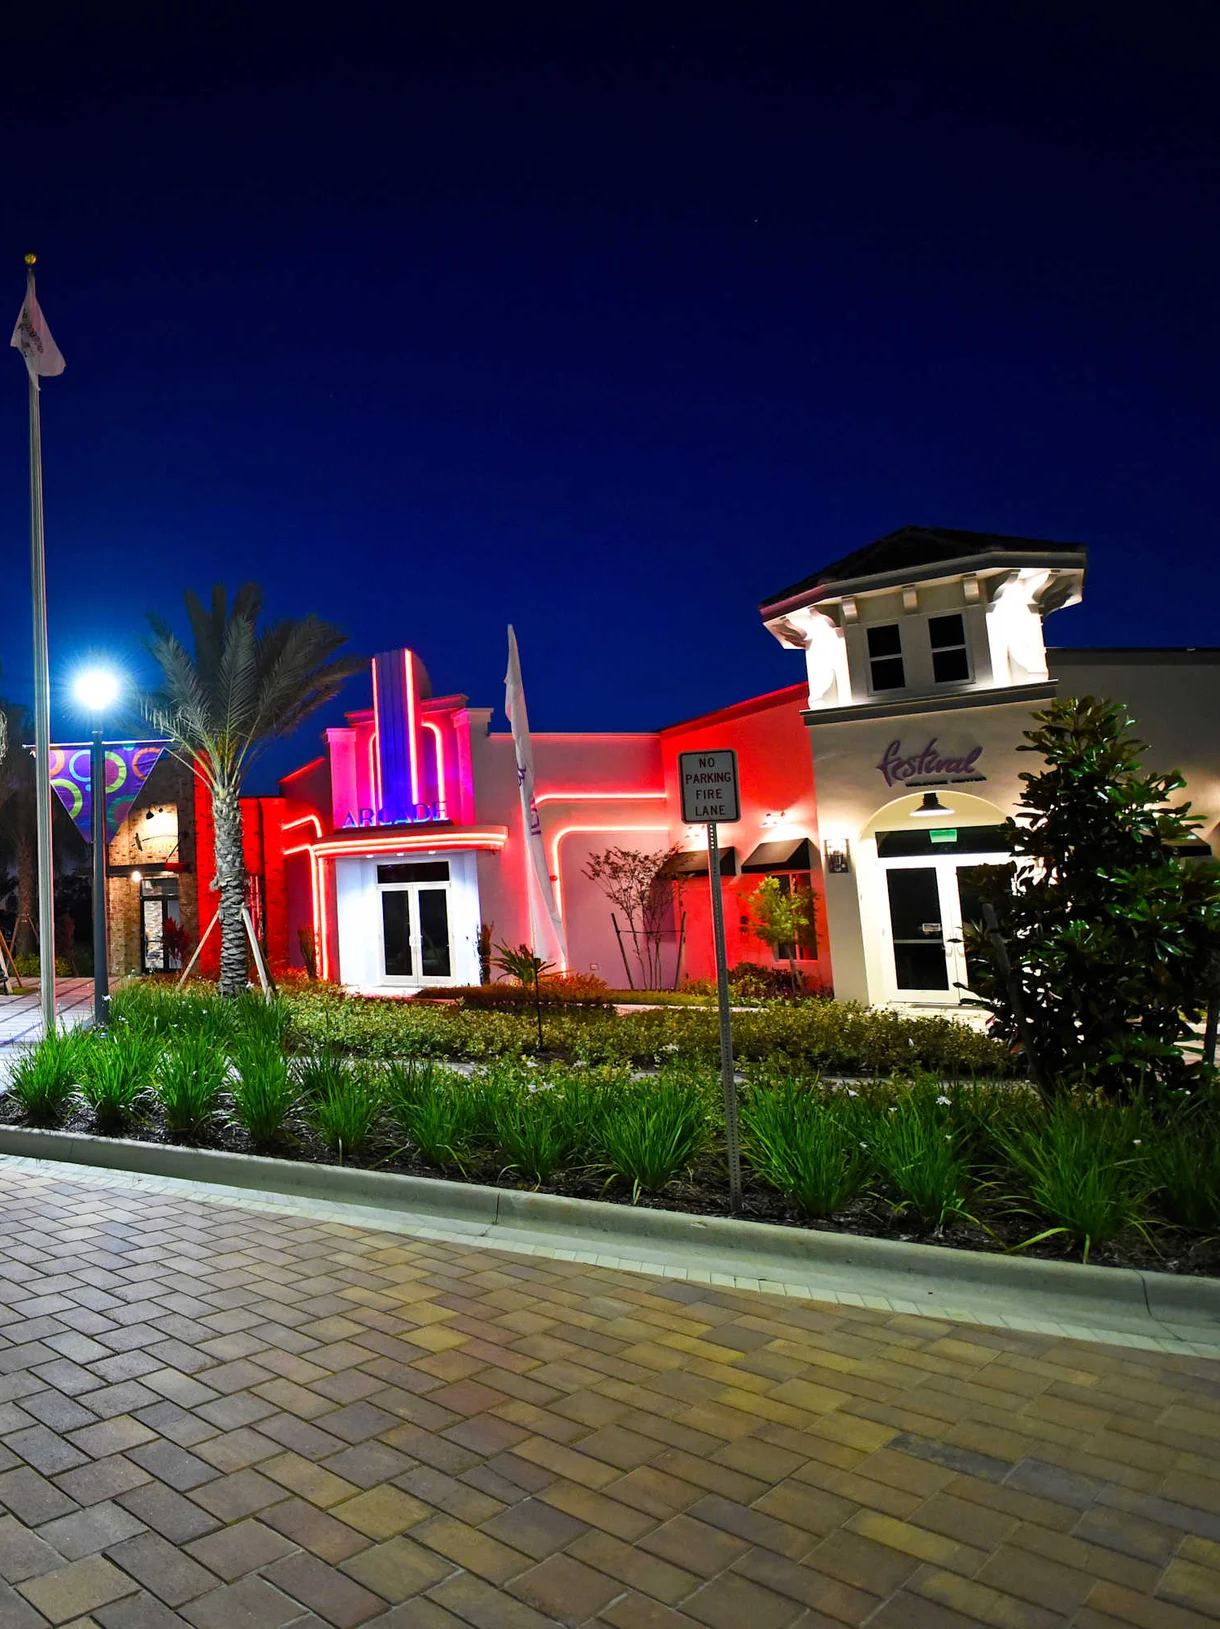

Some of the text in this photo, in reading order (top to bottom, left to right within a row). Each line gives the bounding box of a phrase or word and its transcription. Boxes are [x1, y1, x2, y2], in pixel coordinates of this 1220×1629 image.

[698, 757, 715, 768] NO
[685, 771, 731, 784] PARKING
[695, 788, 723, 800] FIRE
[342, 801, 450, 830] ARCADE
[695, 805, 726, 817] LANE
